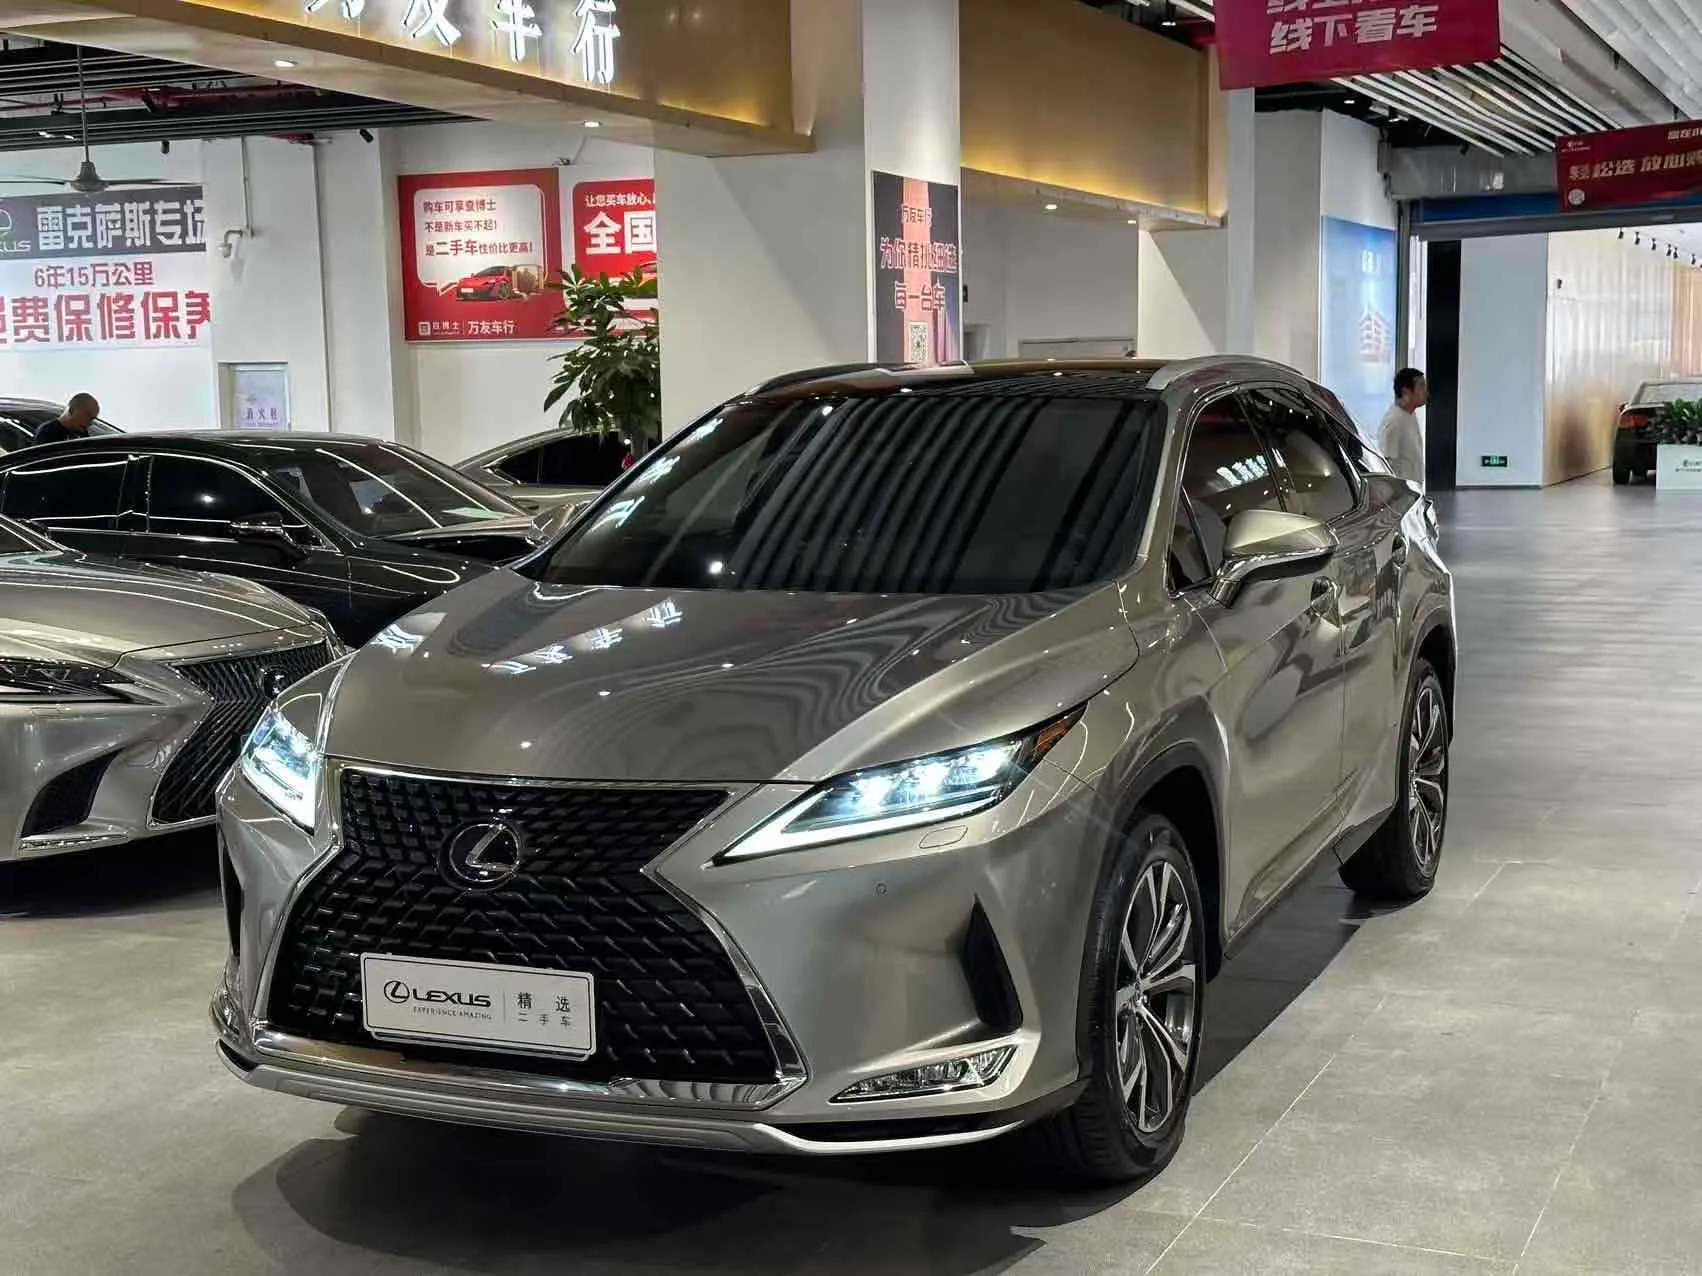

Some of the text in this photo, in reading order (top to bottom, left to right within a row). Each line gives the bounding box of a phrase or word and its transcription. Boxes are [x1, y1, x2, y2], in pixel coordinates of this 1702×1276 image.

[1269, 5, 1439, 54] 线下看车
[585, 192, 655, 207] 让您买车放心、
[37, 199, 206, 250] 雷克萨斯专场
[584, 211, 657, 255] 全国
[34, 261, 153, 288] 6年15万公里
[0, 290, 210, 343] 费保修保养
[467, 319, 515, 335] 万友车行
[412, 988, 491, 1008] LEXUS
[517, 991, 570, 1013] 精选
[518, 1012, 570, 1027] 二手车
